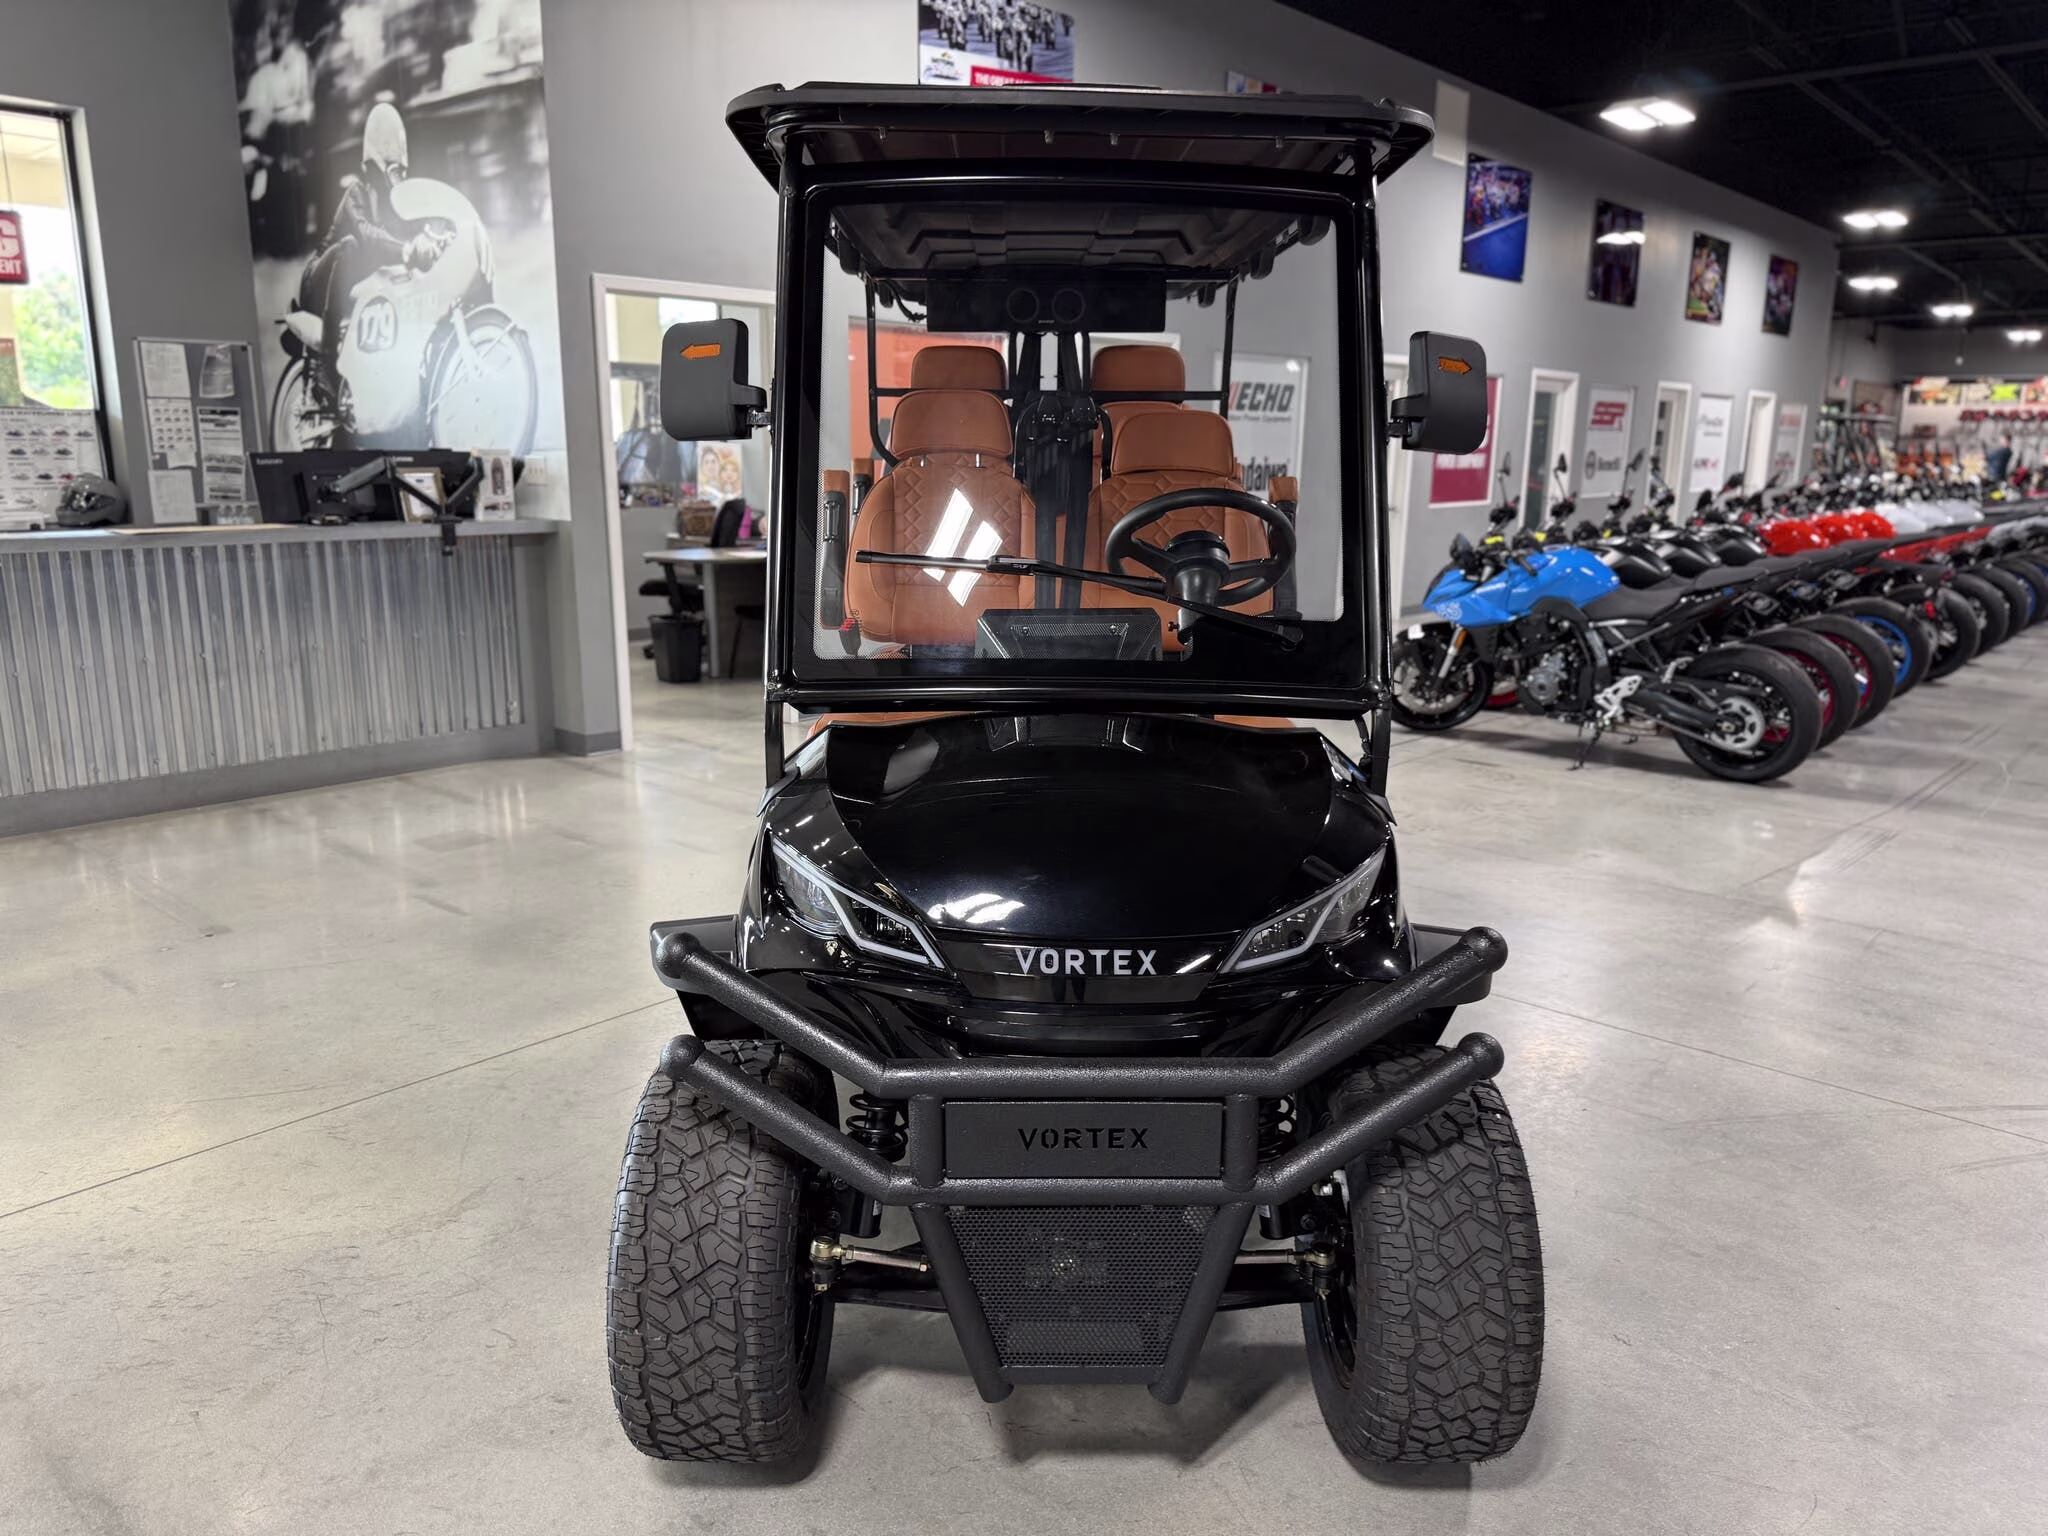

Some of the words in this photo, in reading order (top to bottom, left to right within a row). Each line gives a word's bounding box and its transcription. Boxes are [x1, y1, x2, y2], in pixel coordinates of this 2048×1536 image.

[1236, 382, 1295, 412] ECHO
[1015, 948, 1158, 976] VORTEX
[1017, 1127, 1149, 1151] VORTEX
